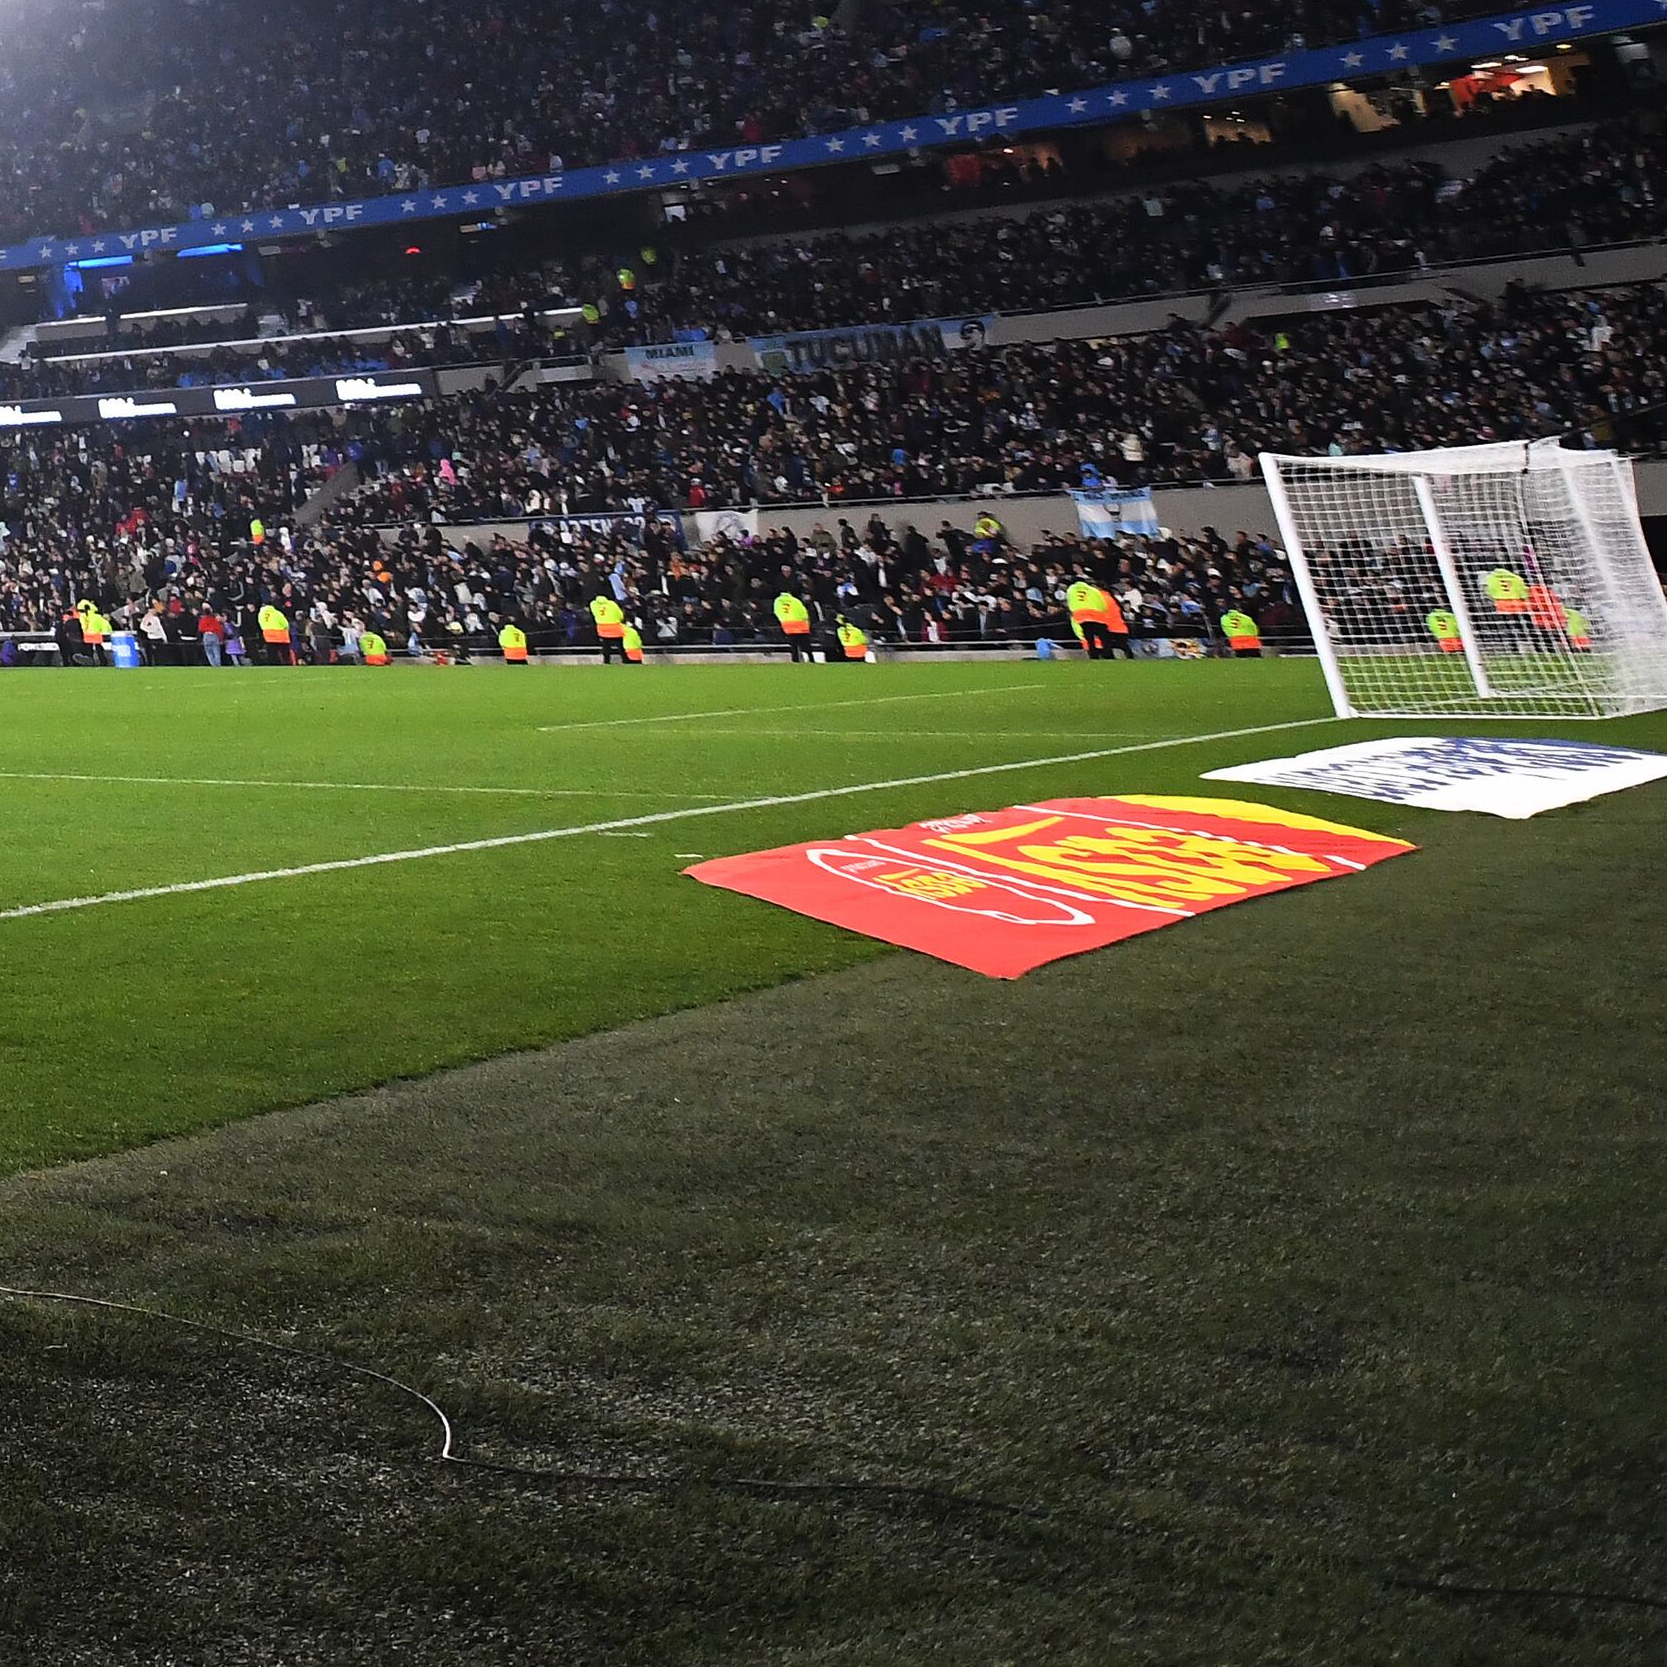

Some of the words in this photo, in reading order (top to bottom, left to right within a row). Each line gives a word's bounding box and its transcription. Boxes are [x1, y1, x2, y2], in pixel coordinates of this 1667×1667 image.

[1492, 5, 1597, 40] YPF
[1192, 63, 1285, 93] YPF
[935, 108, 1017, 134] YPF
[707, 146, 782, 169] YPF
[494, 177, 562, 199] YPF
[299, 205, 362, 224] YPF
[119, 226, 176, 249] YPF
[645, 346, 694, 360] MIAMI
